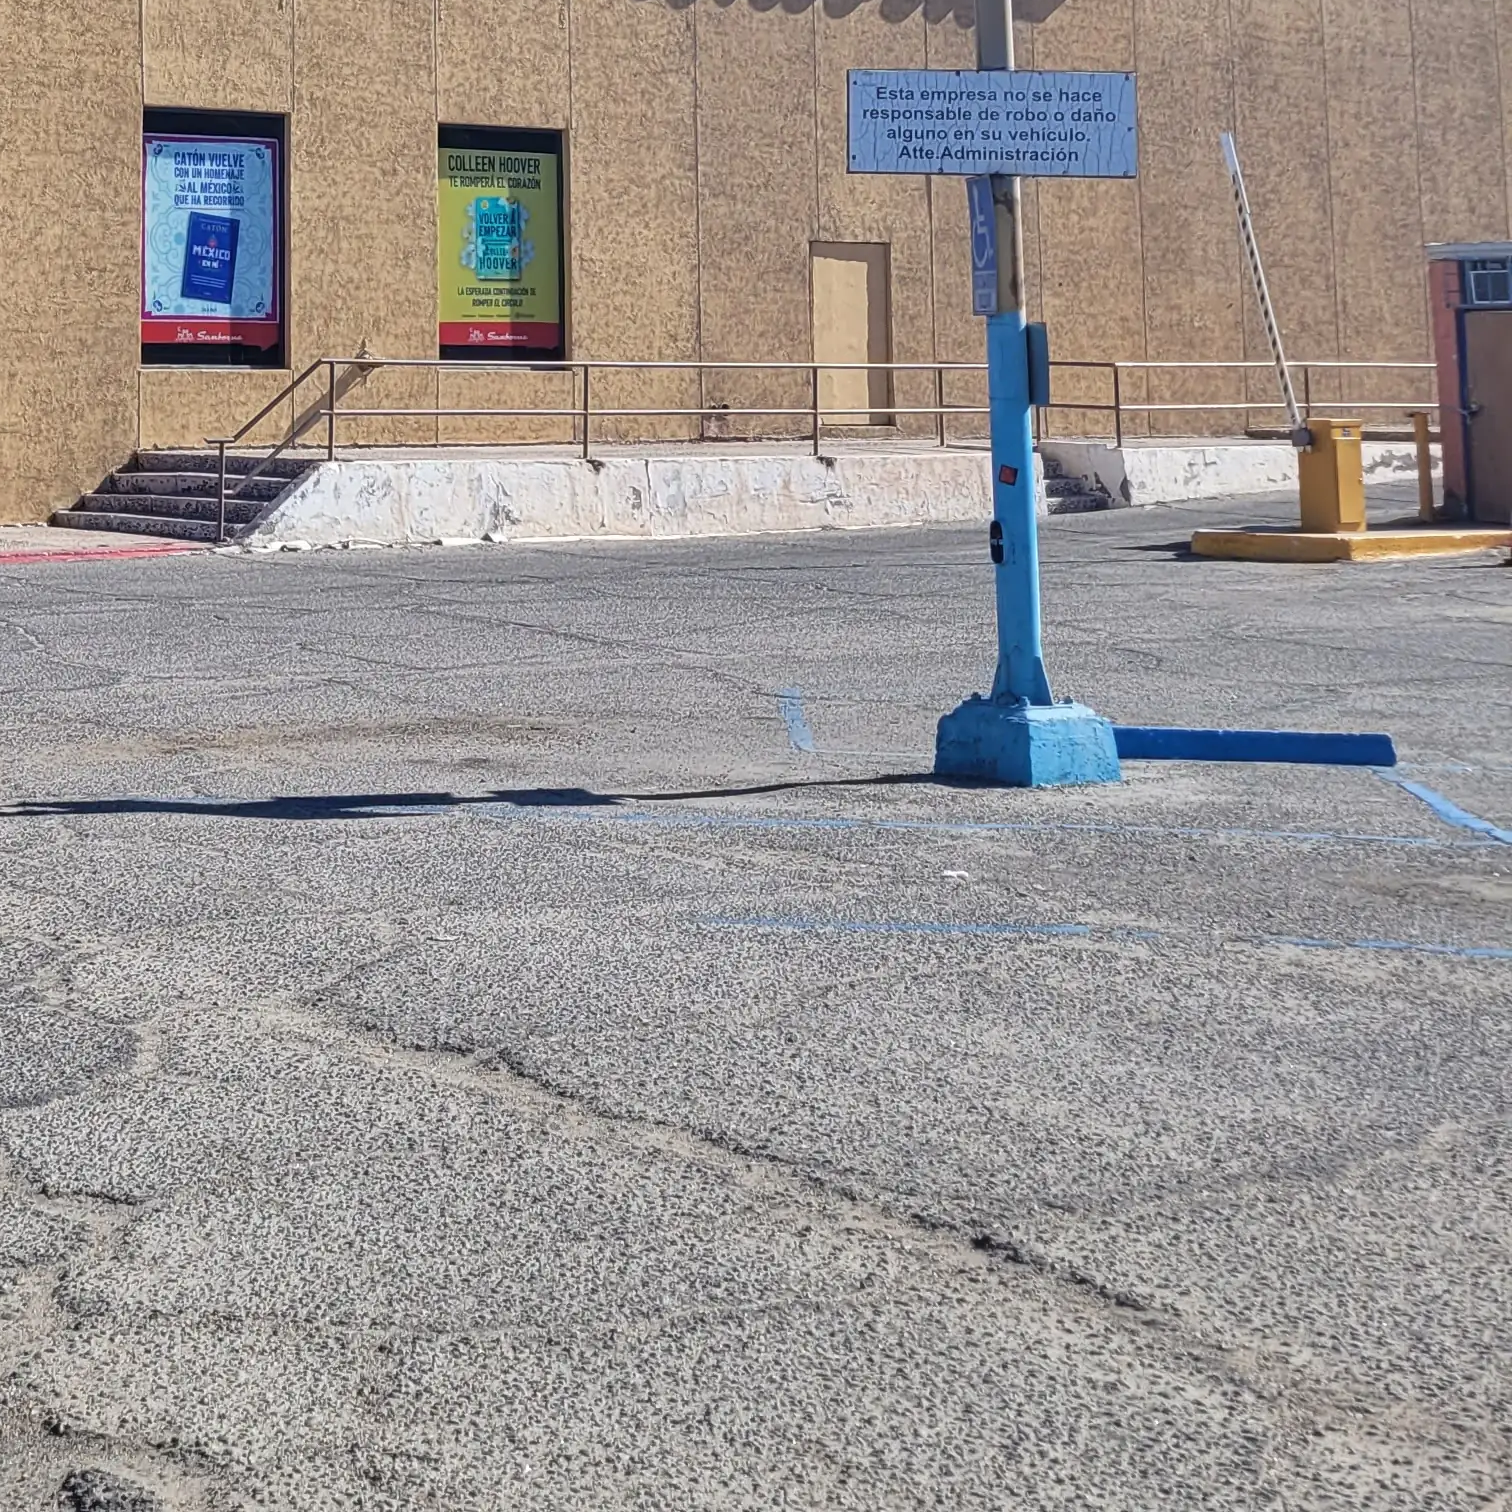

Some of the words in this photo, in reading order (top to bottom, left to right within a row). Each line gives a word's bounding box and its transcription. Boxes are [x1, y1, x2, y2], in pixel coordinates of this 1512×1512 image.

[876, 87, 915, 101] Esta
[920, 88, 997, 105] empresa
[1004, 91, 1026, 102] no
[1032, 92, 1053, 102] se
[1059, 89, 1102, 103] hace
[863, 106, 972, 124] responsable
[978, 108, 1000, 121] de
[1005, 109, 1048, 122] robo
[1054, 111, 1064, 122] o
[1071, 109, 1116, 123] daño
[886, 127, 948, 144] alguno
[954, 129, 975, 140] en
[980, 130, 1002, 141] su
[1008, 128, 1091, 142] vehículo.
[174, 148, 205, 166] CATÓN
[209, 153, 244, 168] VUELVE
[448, 155, 495, 172] COLLEEN
[499, 156, 540, 174] HOOVER
[175, 167, 189, 178] CON
[192, 168, 201, 178] UN
[204, 168, 244, 180] HOMENAJE
[187, 182, 197, 193] AL
[200, 180, 232, 194] MÉXICO
[448, 176, 458, 187] TE
[460, 174, 495, 188] ROMPERÁ
[497, 177, 505, 188] EL
[508, 176, 541, 190] CORAZÓN
[174, 194, 189, 206] QUE
[191, 195, 201, 204] HA
[204, 196, 244, 206] RECORRIDO
[479, 213, 508, 224] VOLVER
[479, 226, 516, 237] EMPEZAR
[192, 245, 230, 260] MÉXICO
[479, 257, 517, 270] HOOVER
[458, 287, 464, 295] LA
